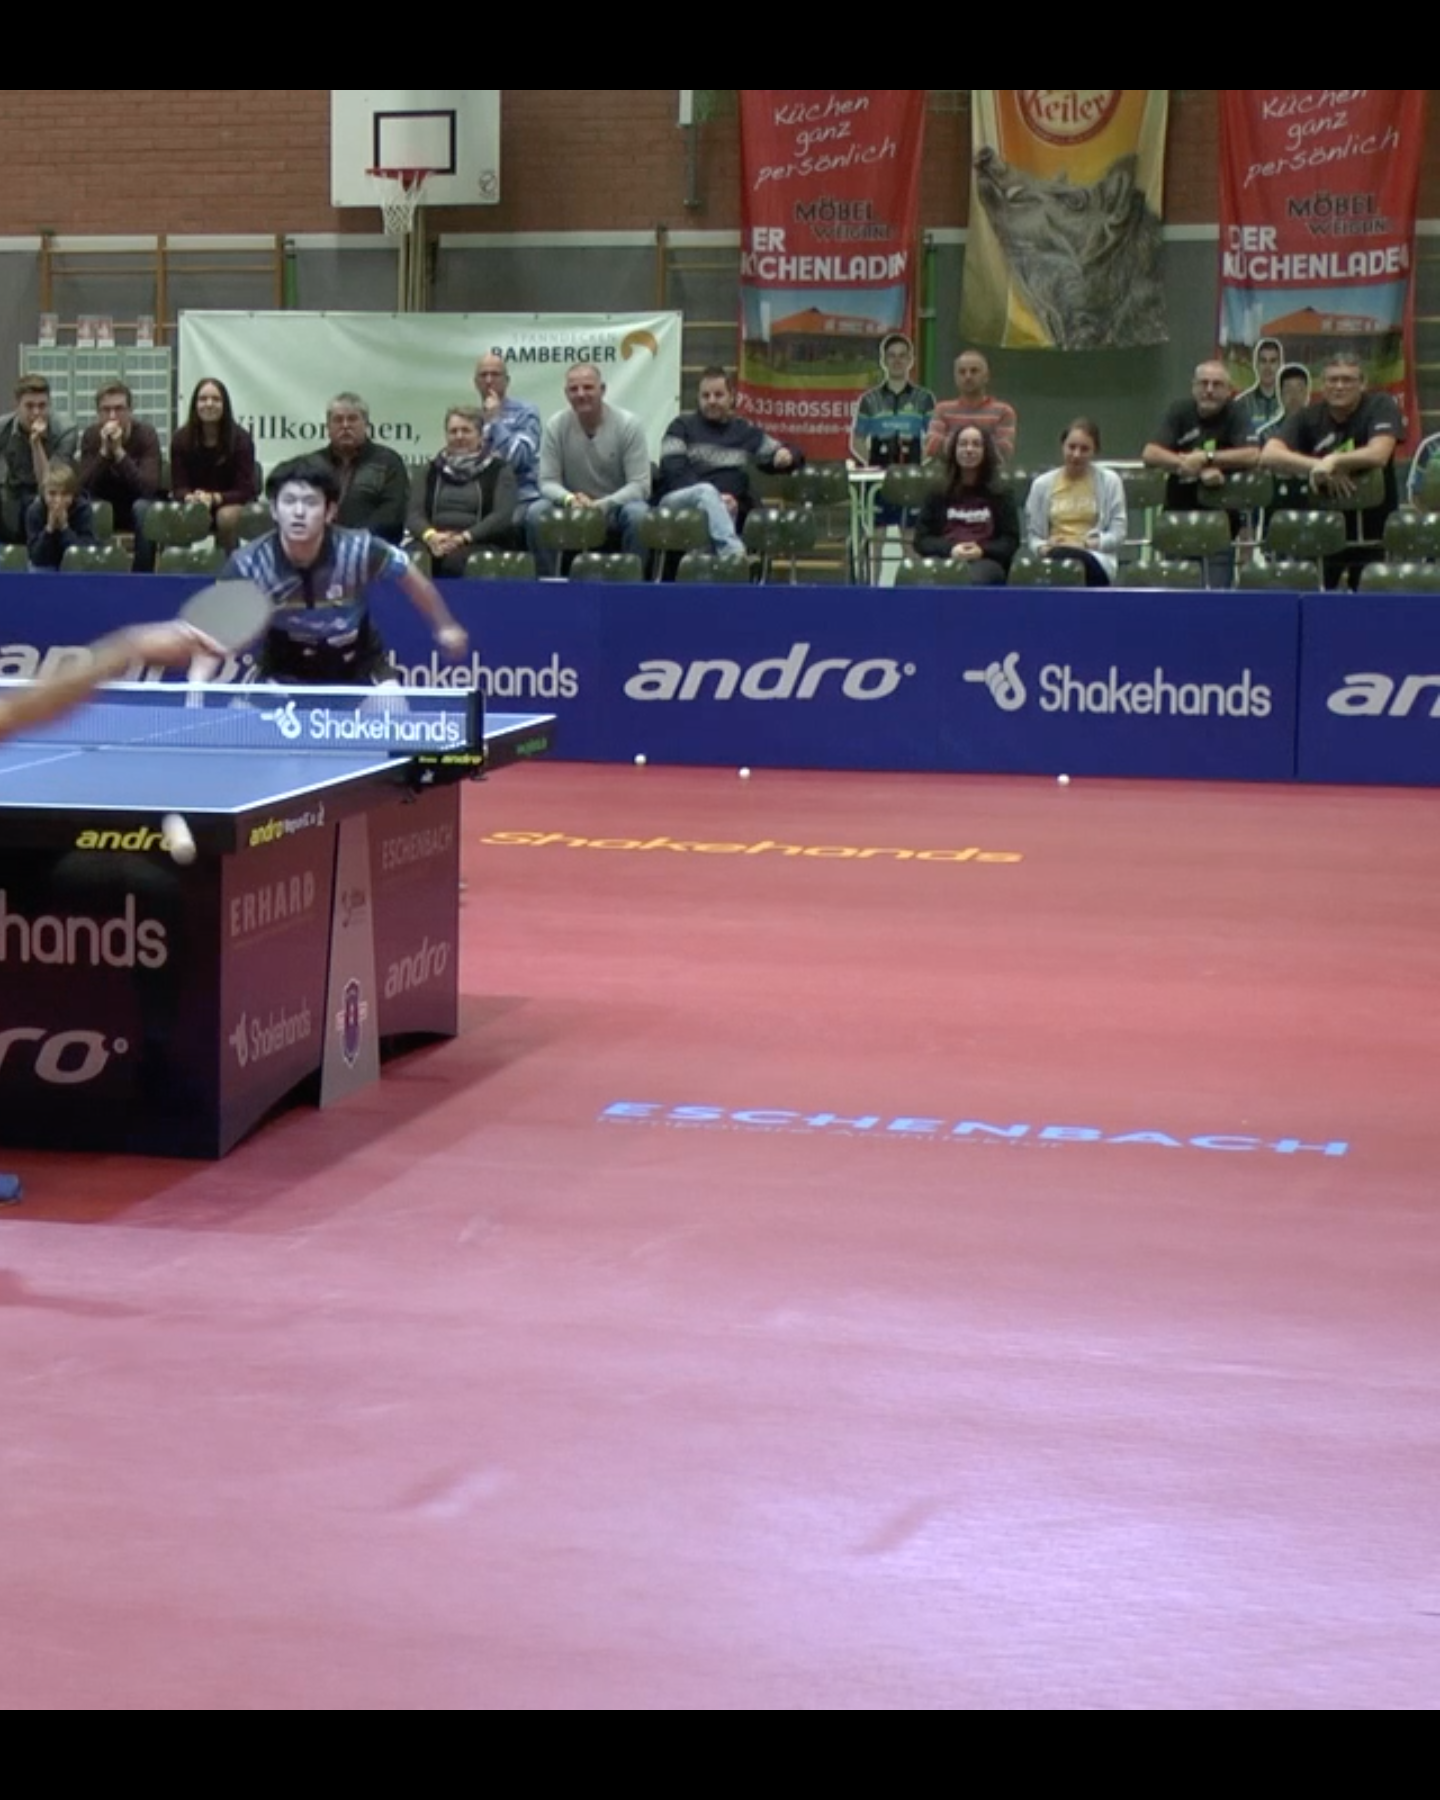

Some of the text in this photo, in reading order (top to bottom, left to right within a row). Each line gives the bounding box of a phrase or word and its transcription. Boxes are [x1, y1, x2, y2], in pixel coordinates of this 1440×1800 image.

[773, 95, 869, 126] Küchen
[1285, 111, 1348, 151] ganz
[753, 136, 897, 191] persönlich
[794, 121, 851, 156] ganz
[1243, 126, 1400, 189] persönlich
[387, 650, 578, 697] hakehands
[624, 643, 903, 700] andro
[1039, 664, 1271, 717] Shakehands
[310, 708, 460, 742] Shakehands
[480, 831, 1024, 863] Shakehands
[230, 870, 315, 937] ERHARD
[385, 936, 448, 999] andro
[601, 1101, 1350, 1156] ESCHENBACH
